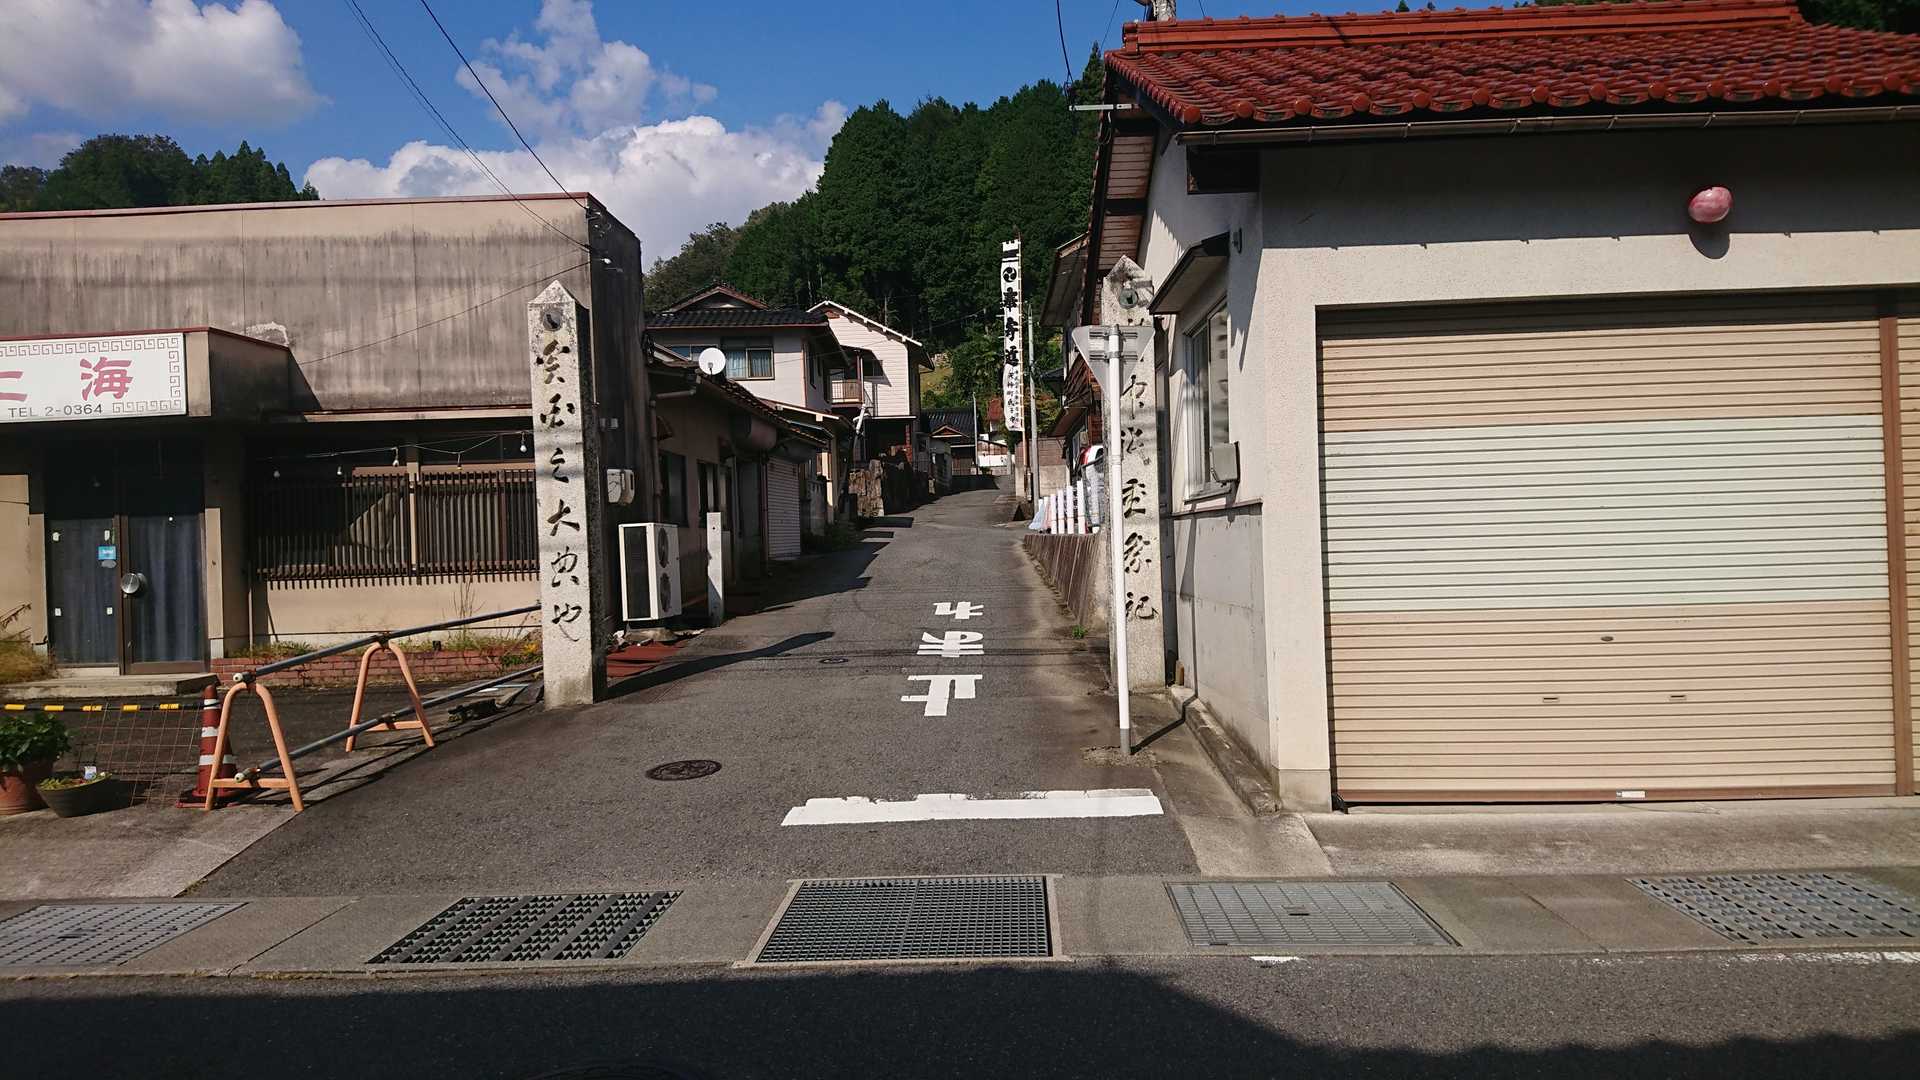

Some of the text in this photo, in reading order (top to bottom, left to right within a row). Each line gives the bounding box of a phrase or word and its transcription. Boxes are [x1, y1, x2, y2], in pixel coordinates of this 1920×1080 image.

[8, 404, 104, 418] TEL 2-0364
[900, 602, 985, 717] 止まれ
